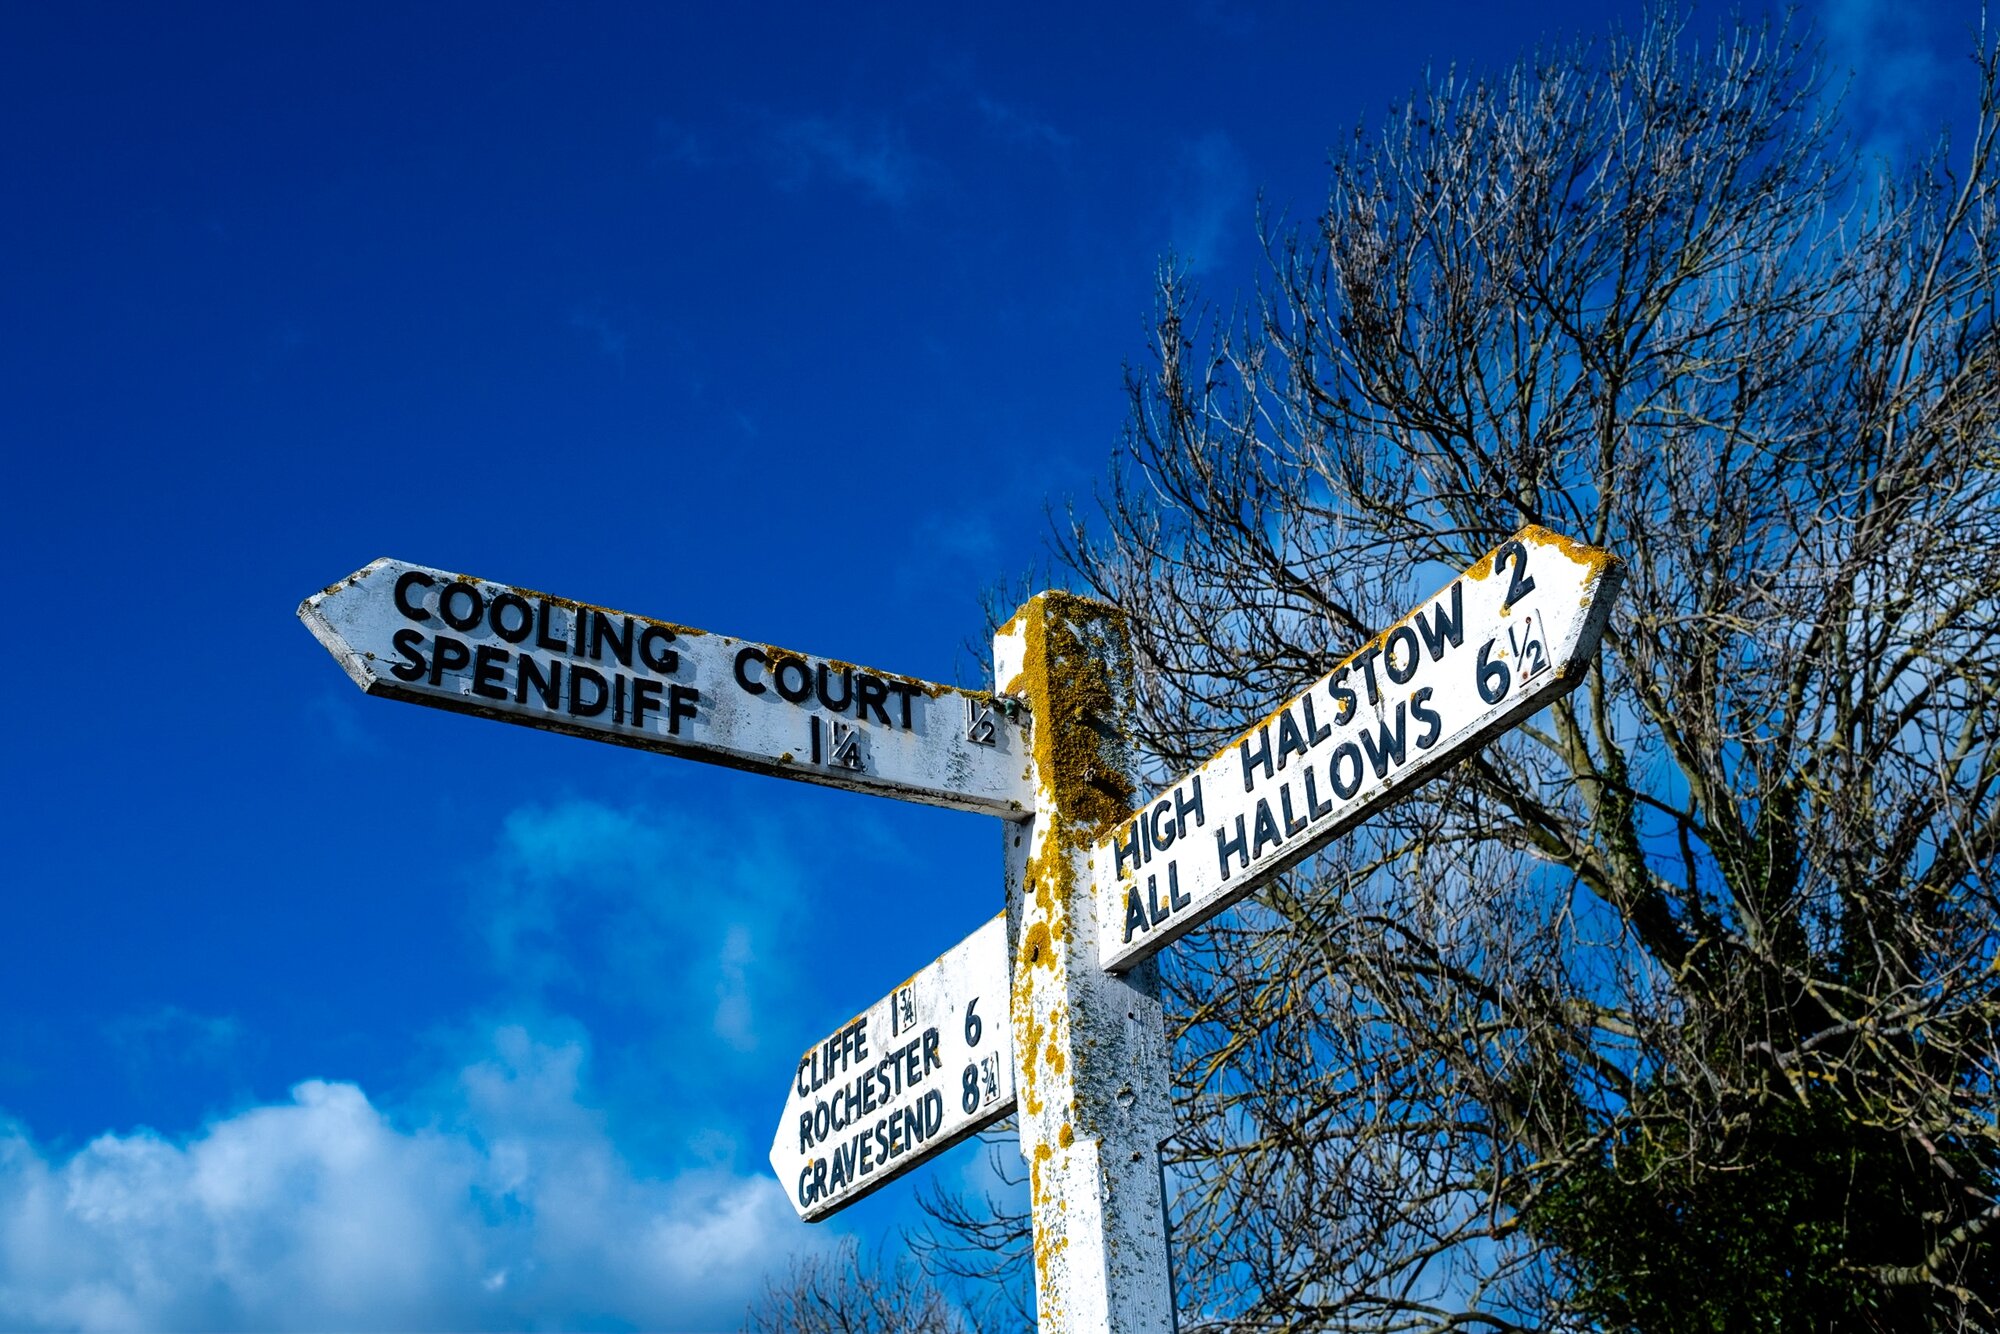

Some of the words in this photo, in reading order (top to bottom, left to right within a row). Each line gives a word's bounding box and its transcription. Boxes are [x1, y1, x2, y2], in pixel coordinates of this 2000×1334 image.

[392, 628, 699, 735] SPENDIFF
[394, 571, 679, 674] COOLING
[734, 647, 922, 729] COURT
[1113, 775, 1205, 881] HIGH
[1240, 580, 1464, 793] HALSTOW
[1494, 540, 1536, 608] 2
[1124, 860, 1191, 943] ALL
[1216, 686, 1442, 881] HALLOWS
[797, 1018, 868, 1098] CLIFFE
[800, 1027, 942, 1154] ROCHESTER
[964, 996, 982, 1047] 6
[799, 1088, 943, 1208] GRAVESEND
